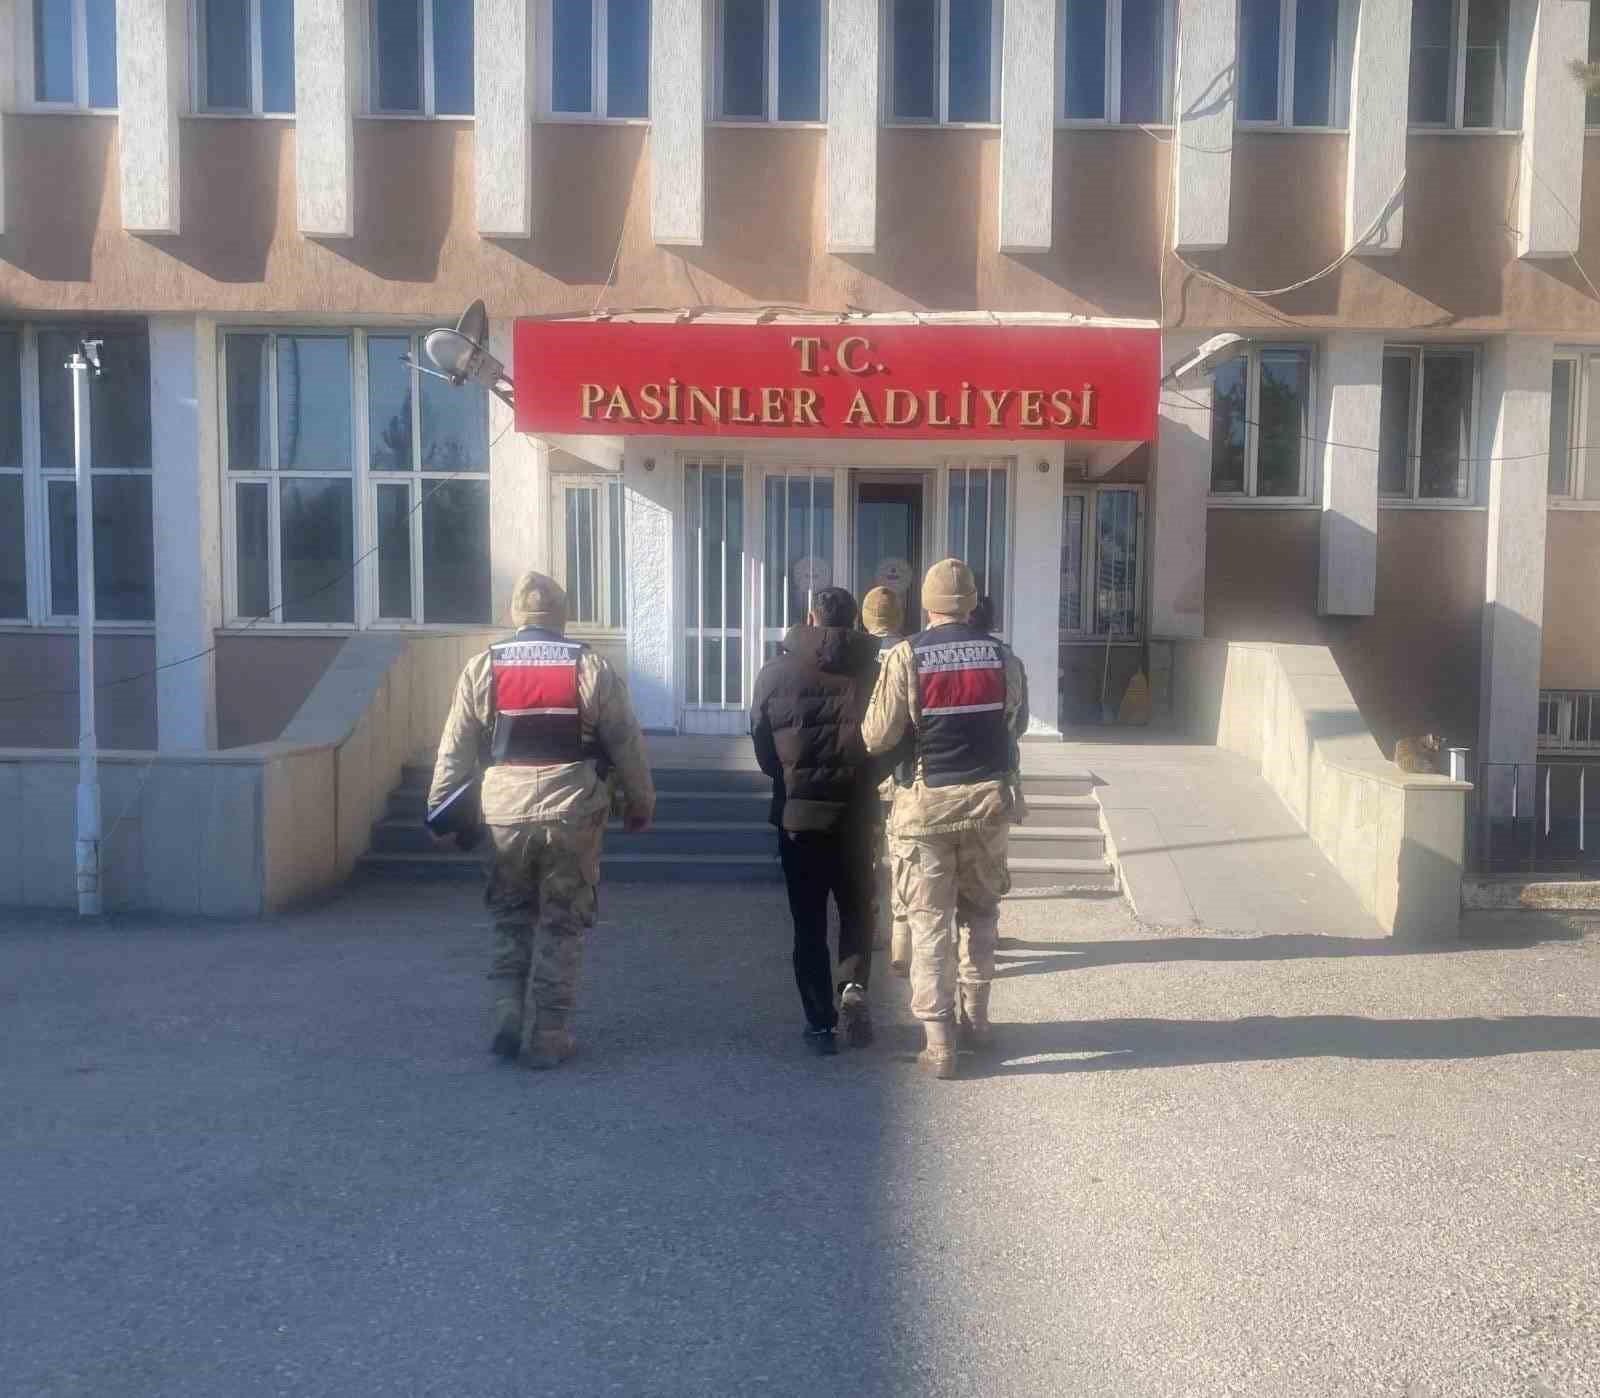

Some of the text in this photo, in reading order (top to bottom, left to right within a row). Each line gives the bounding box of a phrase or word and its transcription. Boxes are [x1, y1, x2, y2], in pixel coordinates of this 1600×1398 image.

[791, 336, 887, 373] T.C.
[579, 377, 1096, 427] PASİNLER ADLİYESİ
[501, 645, 570, 659] JANDARMA
[921, 646, 998, 666] JANDARMA
